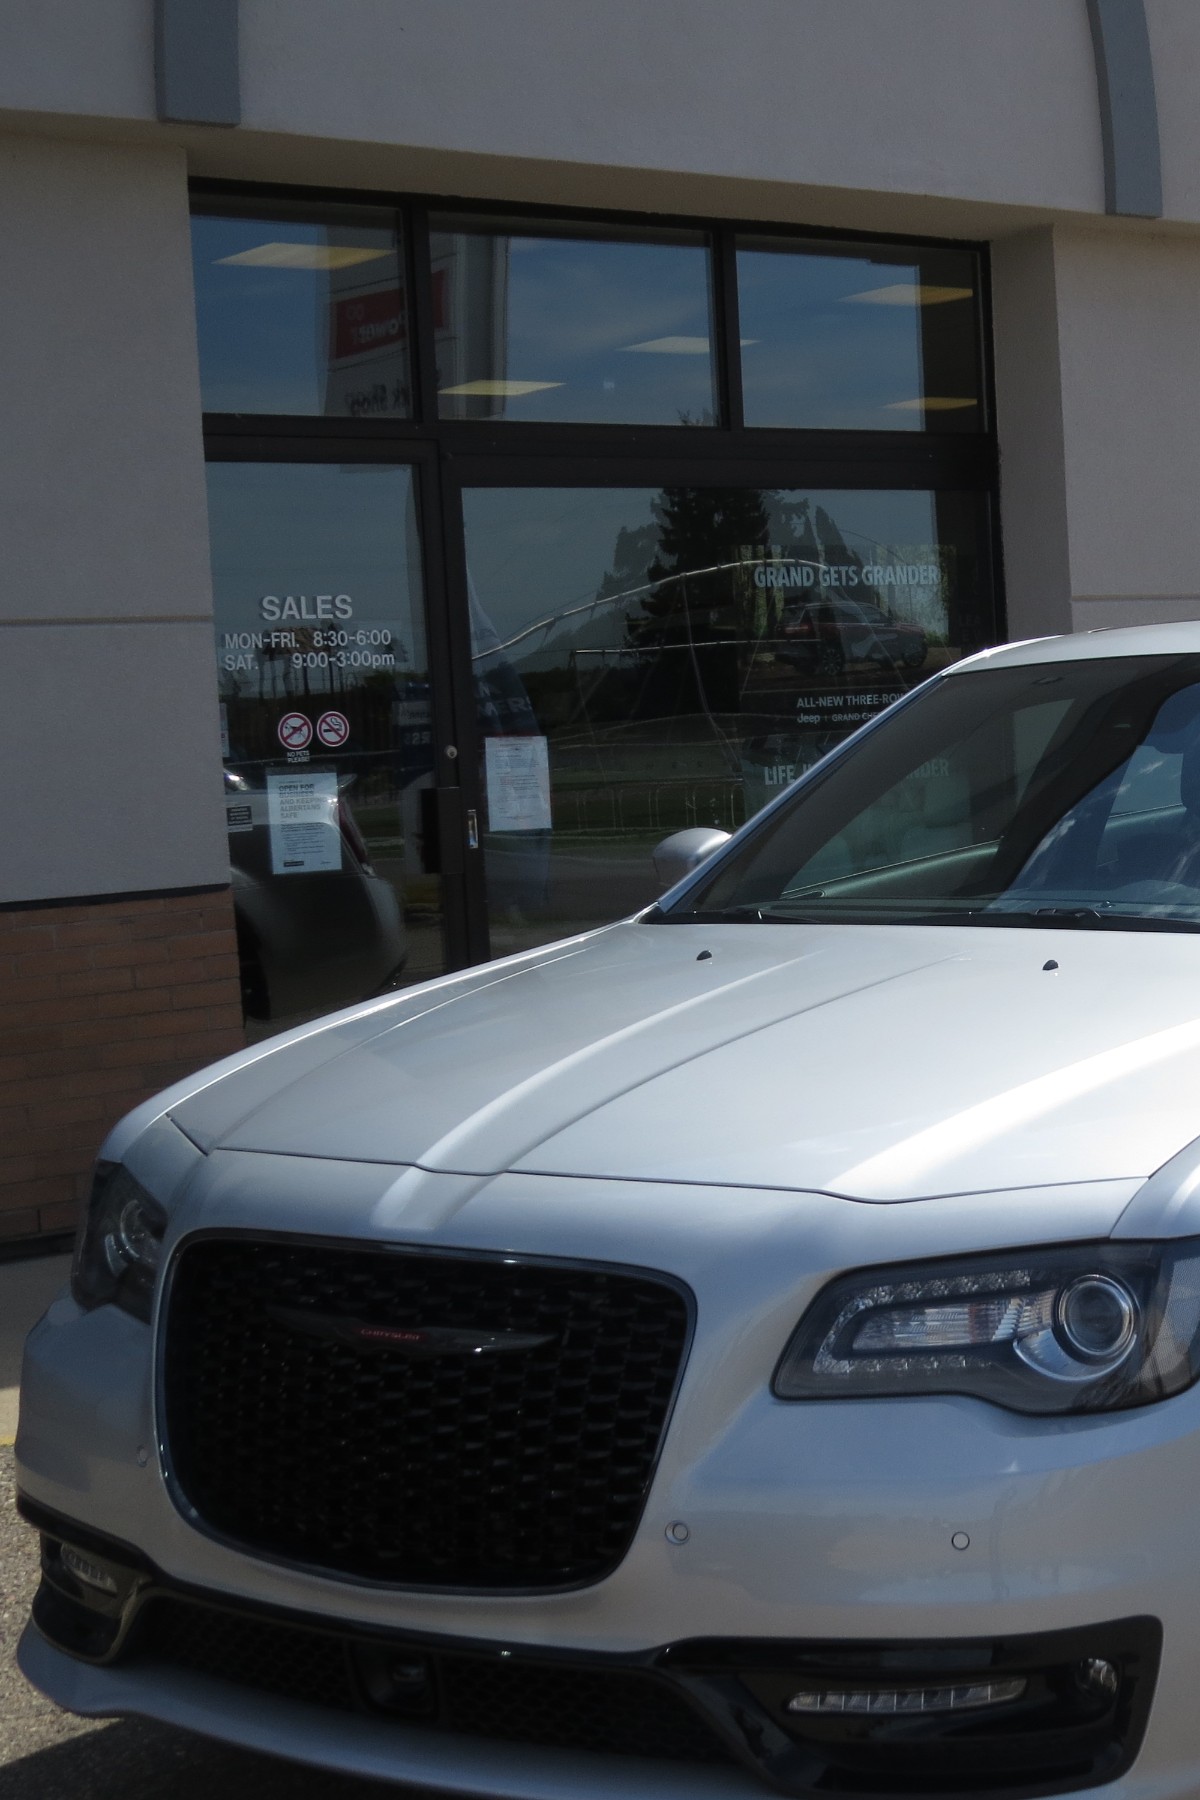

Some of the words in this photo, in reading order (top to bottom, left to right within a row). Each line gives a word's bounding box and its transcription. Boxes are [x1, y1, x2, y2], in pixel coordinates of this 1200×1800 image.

[754, 566, 814, 588] GRAND
[819, 565, 858, 587] GETS
[862, 564, 941, 586] GRANDER
[262, 594, 353, 621] SALES
[225, 631, 300, 650] MON-FRI.
[313, 629, 392, 647] 8:30-6:00
[225, 653, 259, 671] SAT.
[292, 650, 396, 669] 9:00-3:00pm
[797, 696, 844, 709] ALL-NEW
[797, 712, 821, 725] Jeep
[831, 712, 860, 723] GRAND
[764, 764, 796, 785] LIFE
